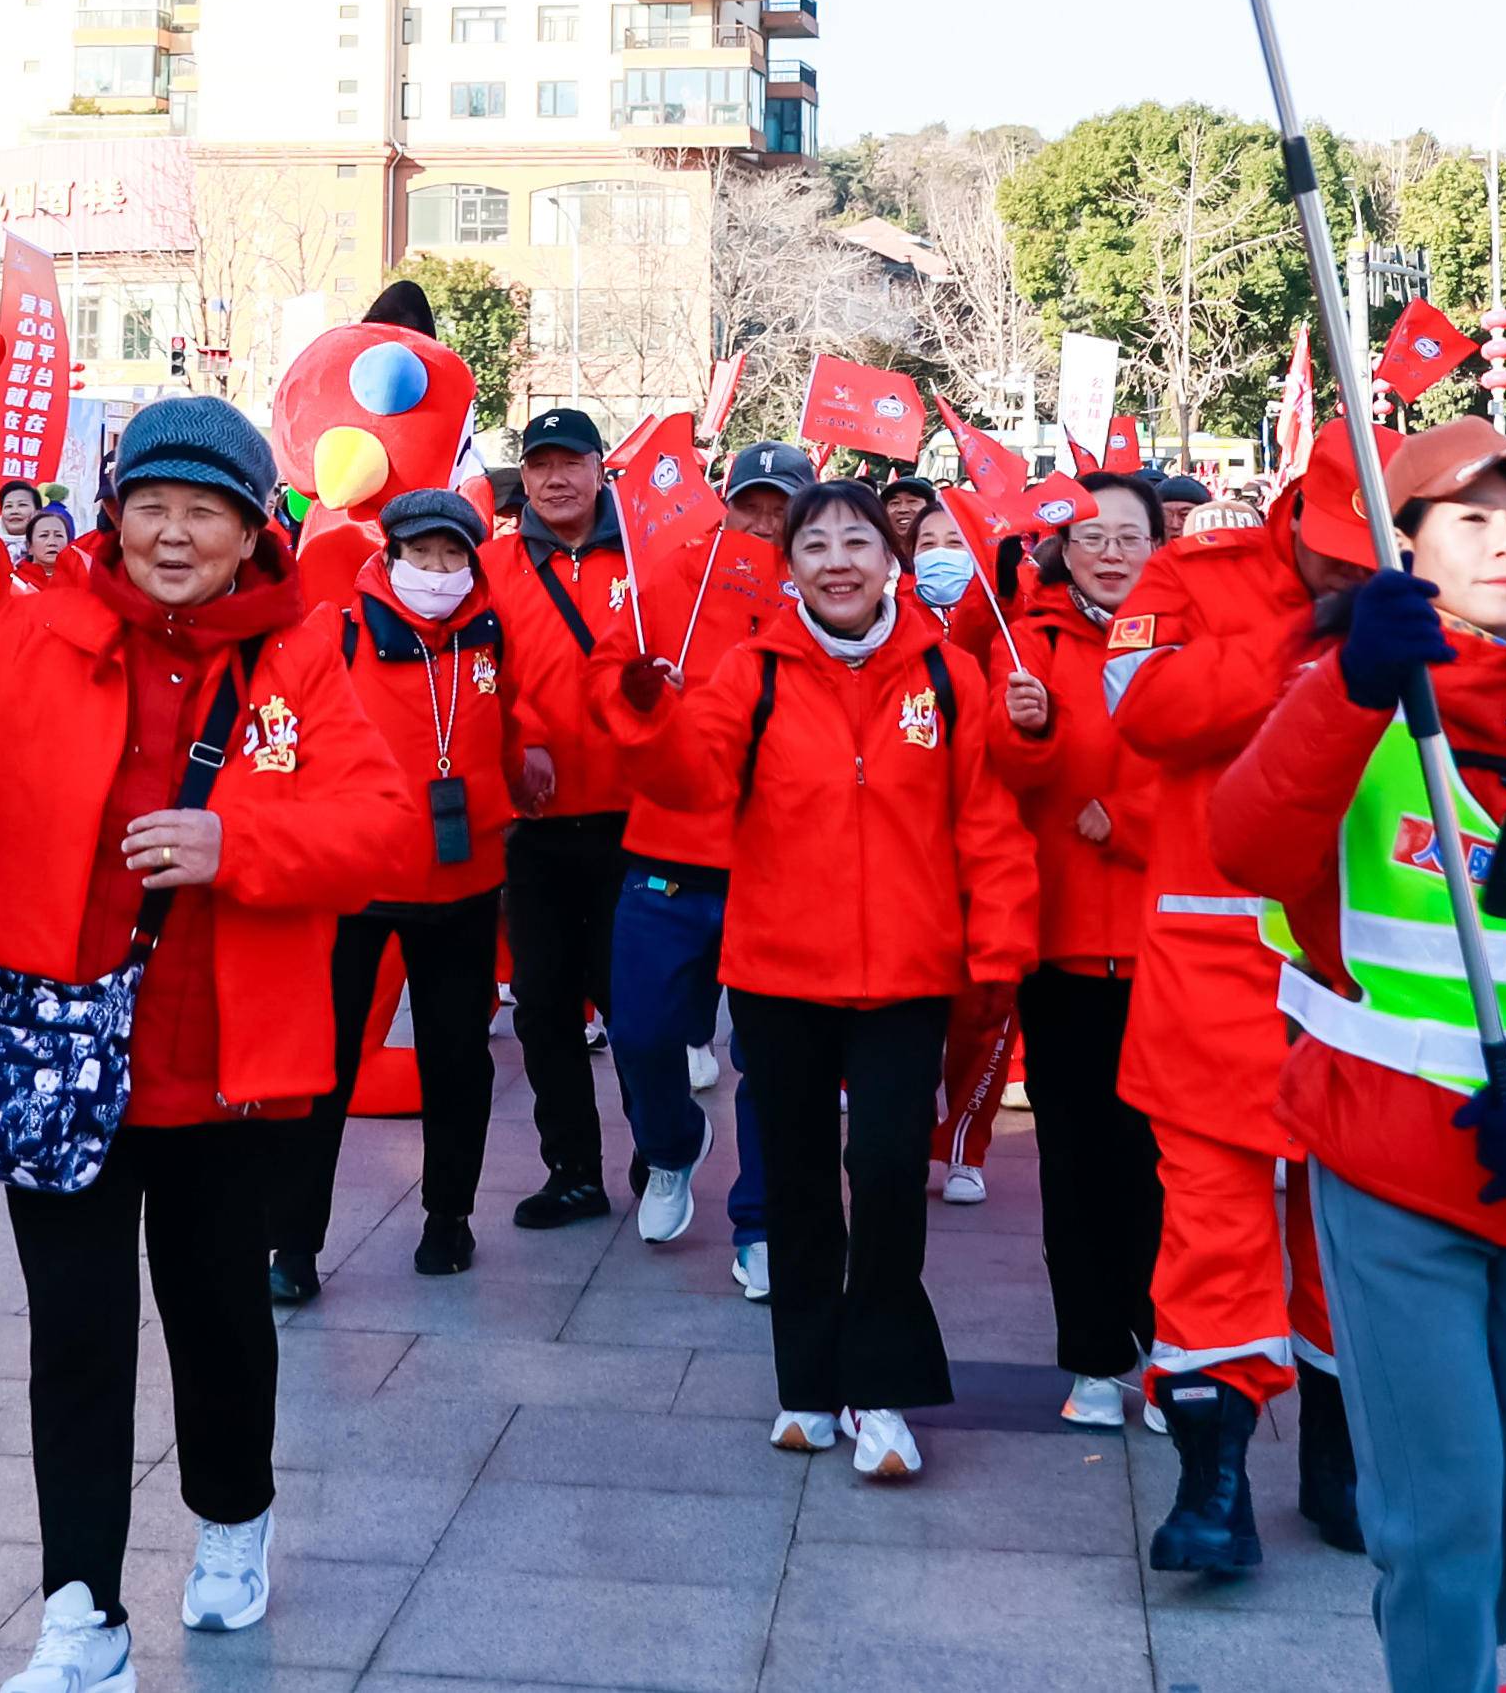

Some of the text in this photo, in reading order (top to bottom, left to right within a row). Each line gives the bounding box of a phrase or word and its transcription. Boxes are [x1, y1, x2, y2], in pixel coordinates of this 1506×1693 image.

[2, 293, 37, 479] 爱心体彩就在身边
[22, 297, 57, 481] 爱心平台就在体彩
